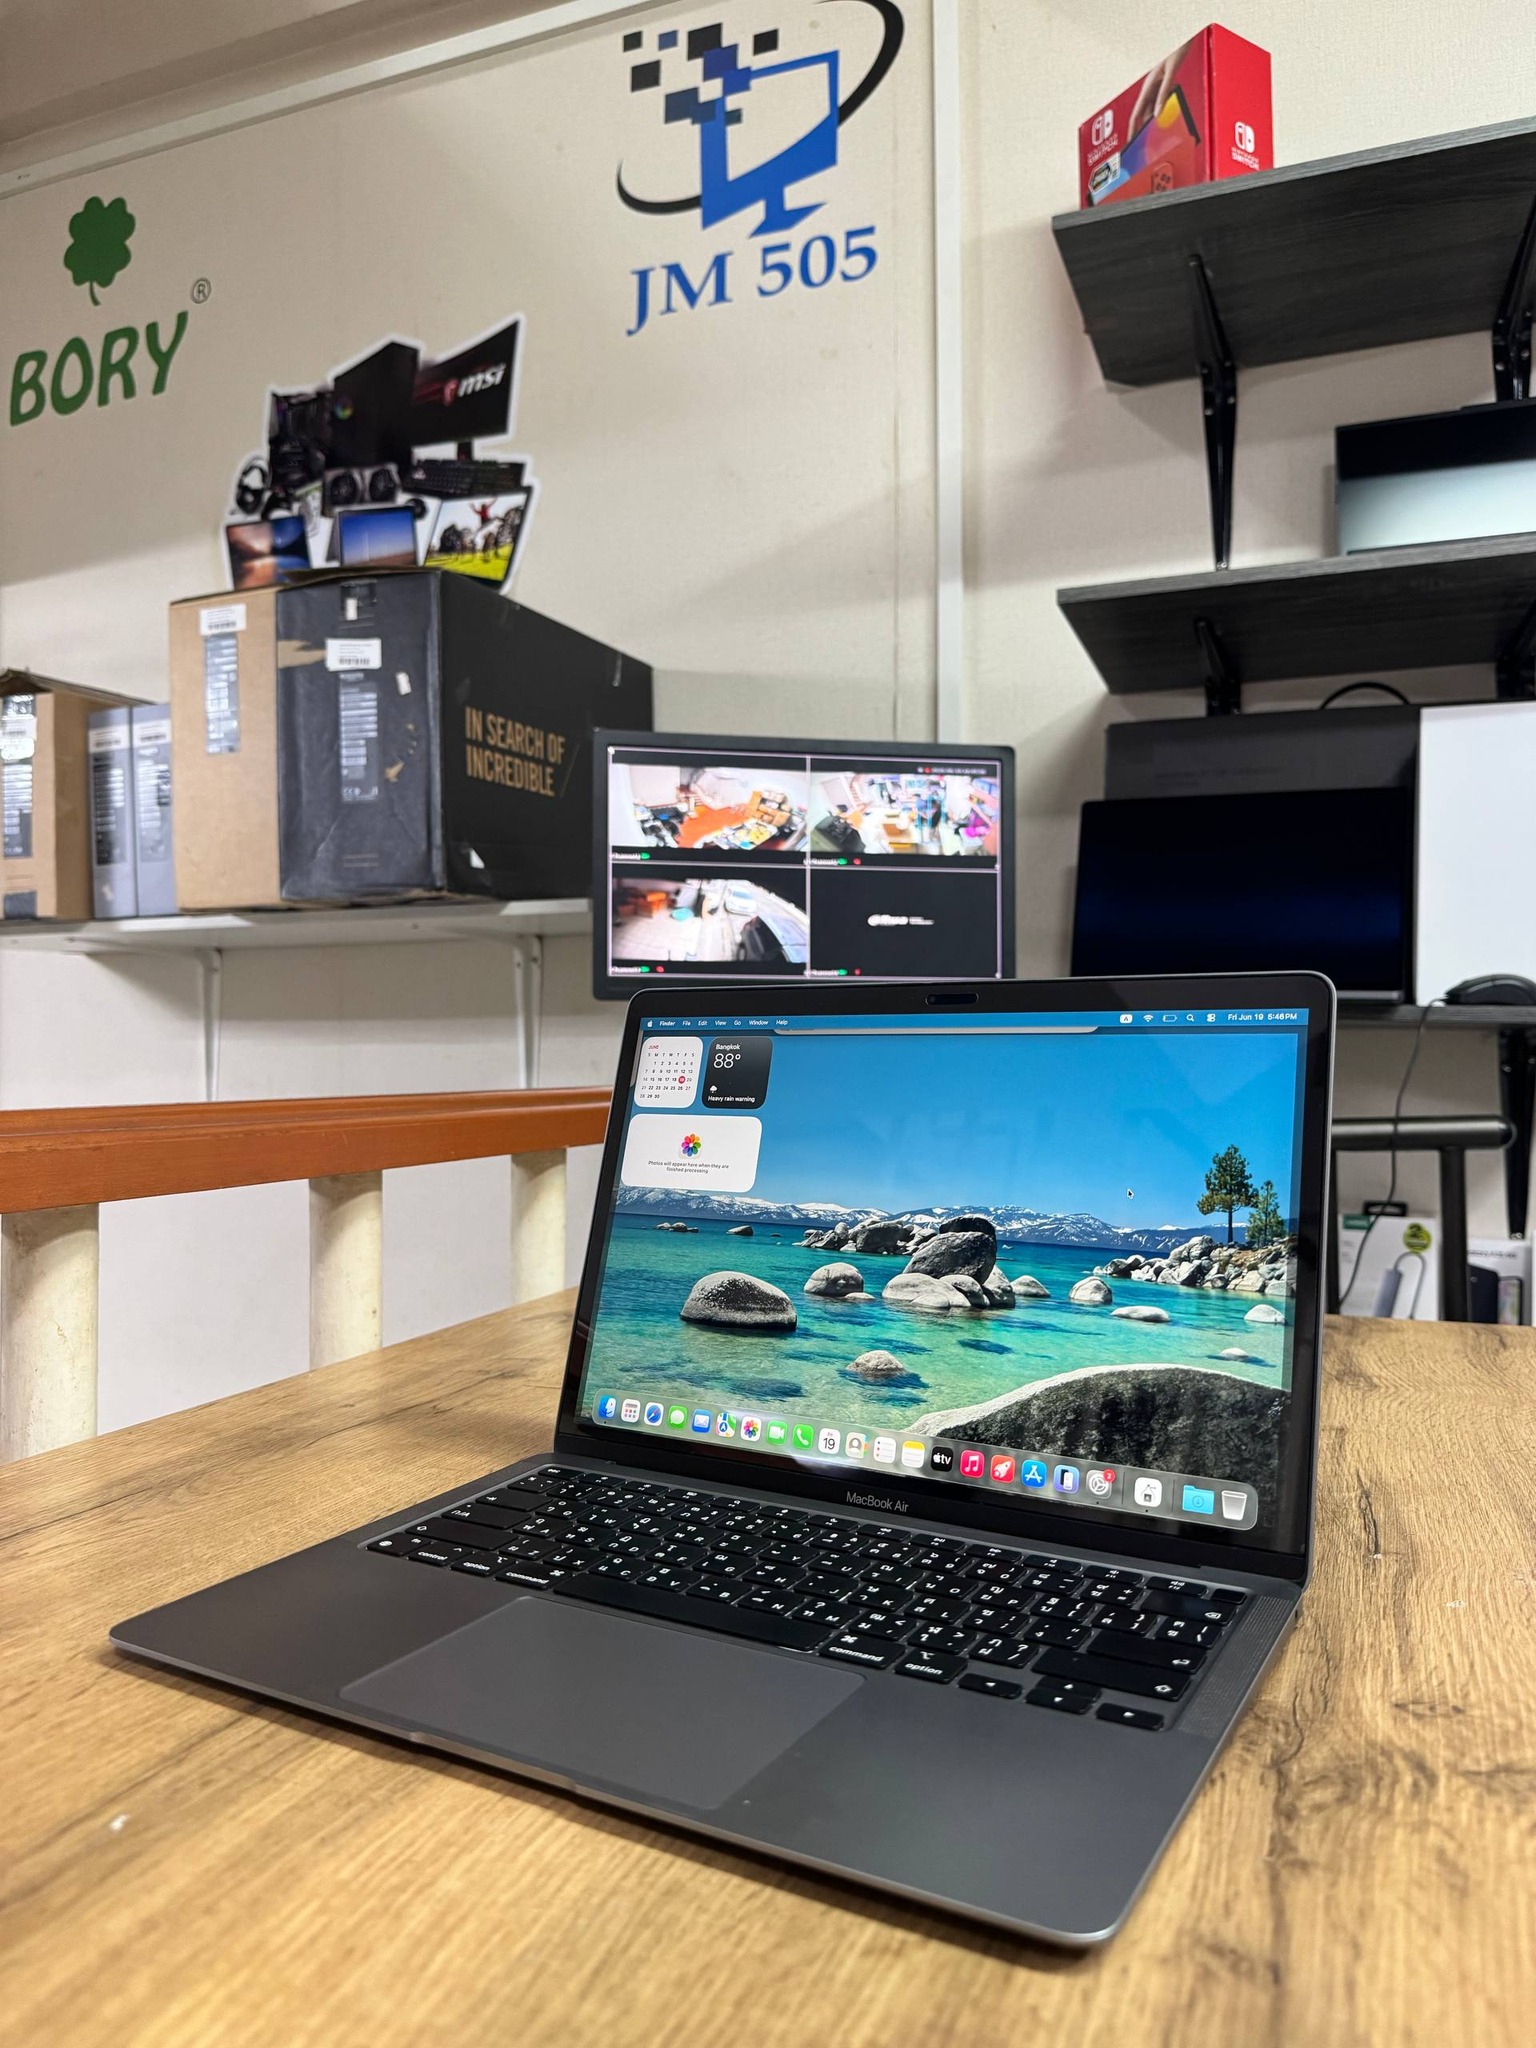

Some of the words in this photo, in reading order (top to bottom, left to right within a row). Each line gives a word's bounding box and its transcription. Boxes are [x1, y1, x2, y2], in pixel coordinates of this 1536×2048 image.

[626, 251, 734, 336] JM
[757, 225, 878, 297] 505
[10, 310, 189, 427] BORY
[457, 362, 507, 398] msi
[465, 706, 483, 742] IN
[486, 711, 545, 760] SEARCH
[547, 732, 566, 766] OF
[465, 744, 555, 798] INCREDIBLE
[715, 1043, 741, 1051] Bangkok
[713, 1053, 742, 1069] 88°
[823, 1437, 836, 1450] 19
[940, 1454, 952, 1465] tv
[846, 1490, 892, 1510] MacBook
[894, 1500, 909, 1512] Air
[418, 1552, 448, 1560] control
[463, 1562, 490, 1570] option
[506, 1572, 549, 1584] command
[829, 1647, 884, 1661] command
[905, 1664, 943, 1674] option
